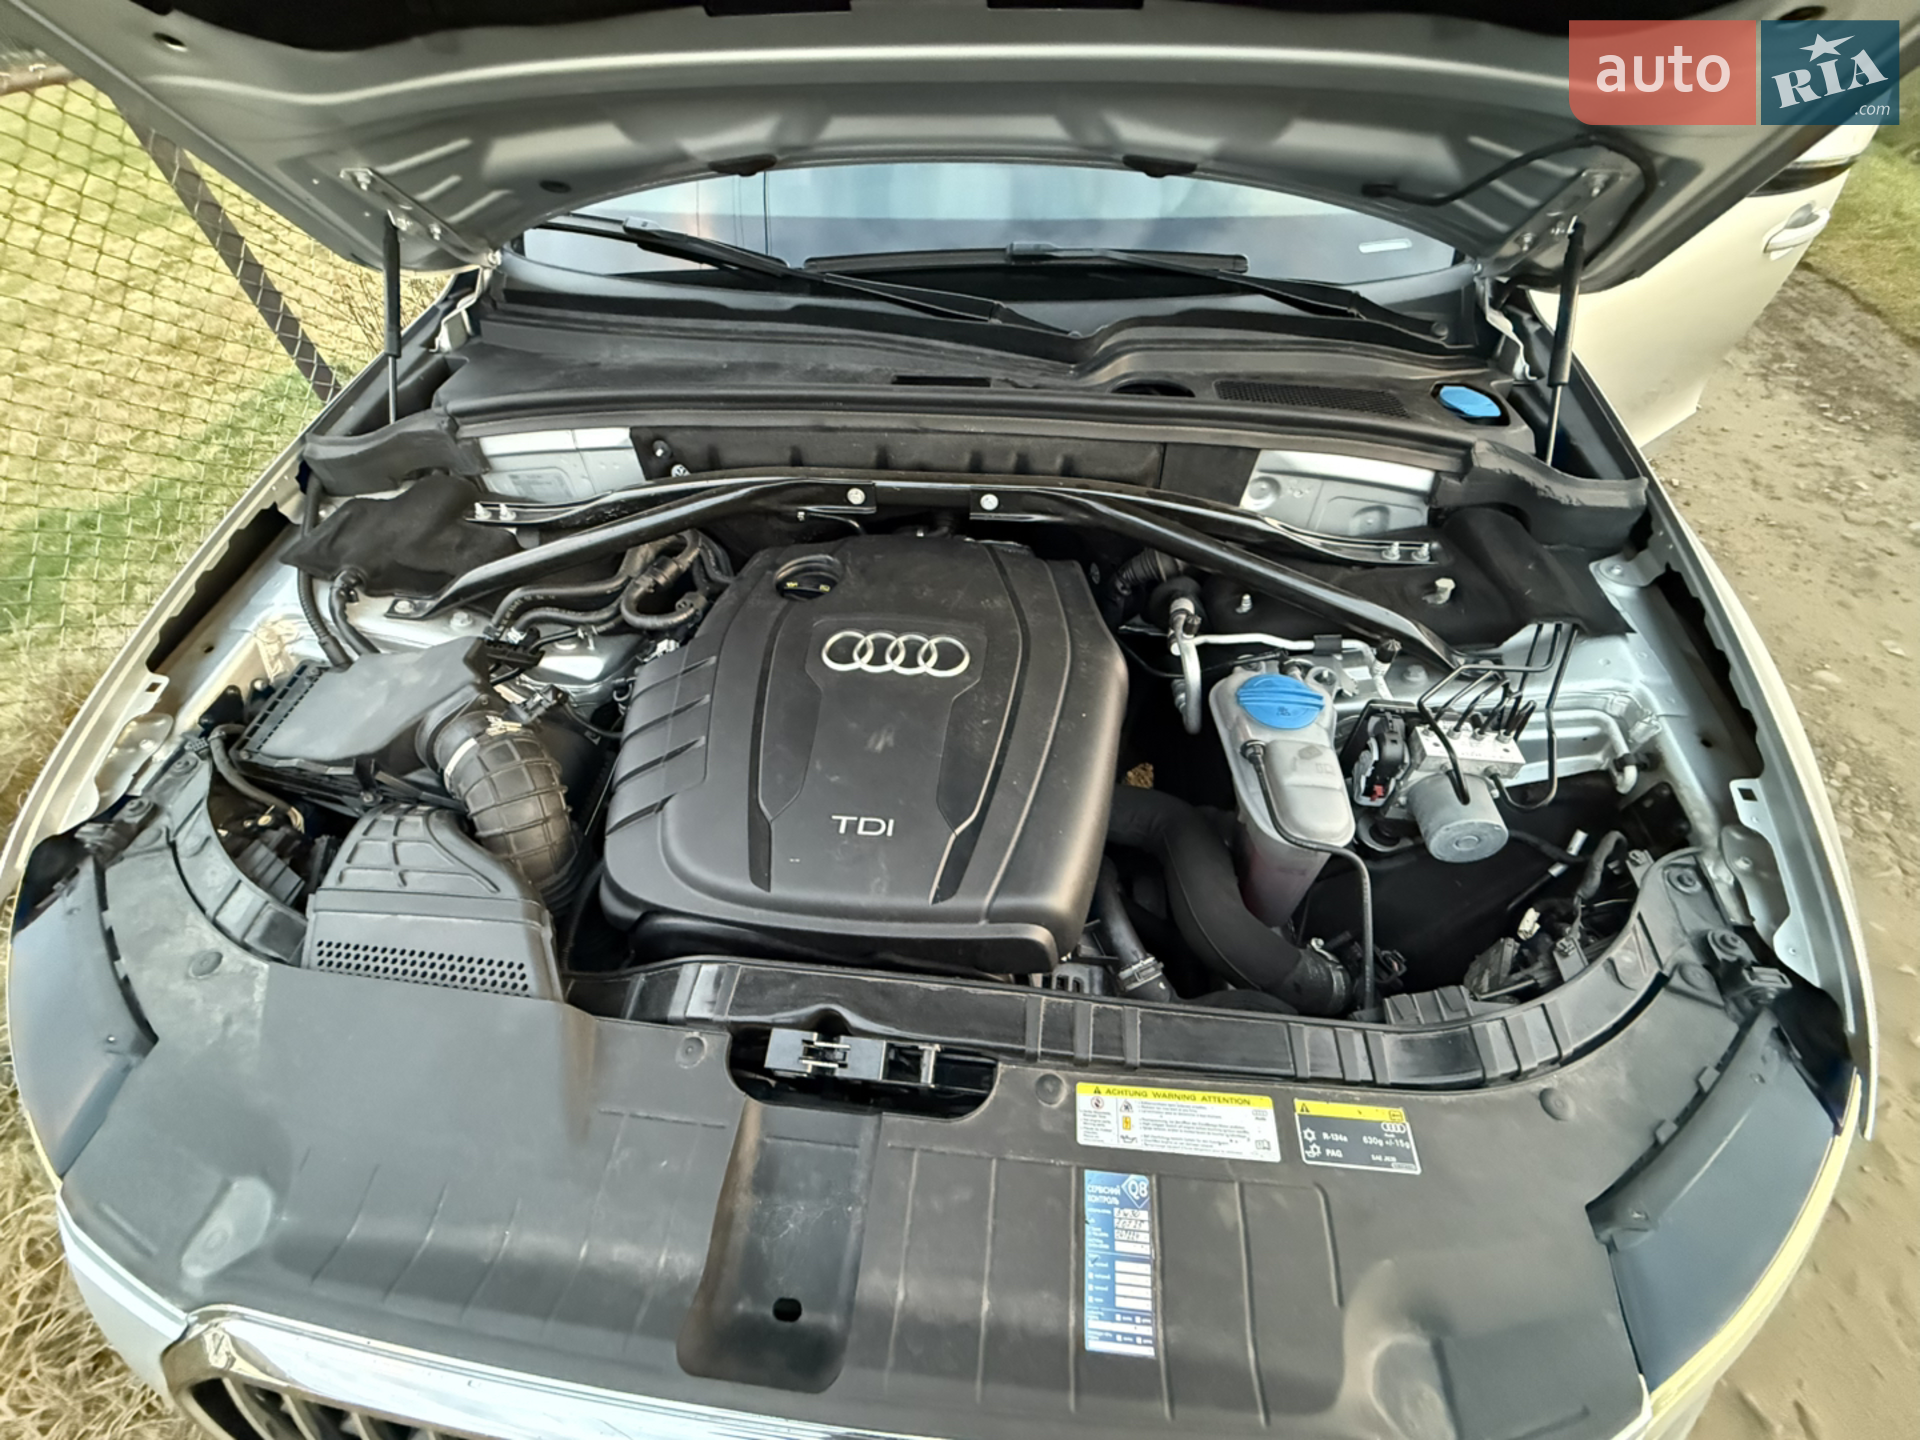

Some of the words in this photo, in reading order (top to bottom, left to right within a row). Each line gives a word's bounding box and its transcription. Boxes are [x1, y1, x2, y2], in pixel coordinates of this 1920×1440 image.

[831, 815, 895, 837] TDI
[1105, 1088, 1148, 1099] ACHTUNG
[1152, 1090, 1197, 1101] WARNING
[1201, 1095, 1251, 1106] ATTENTION
[1128, 1180, 1149, 1200] Q8
